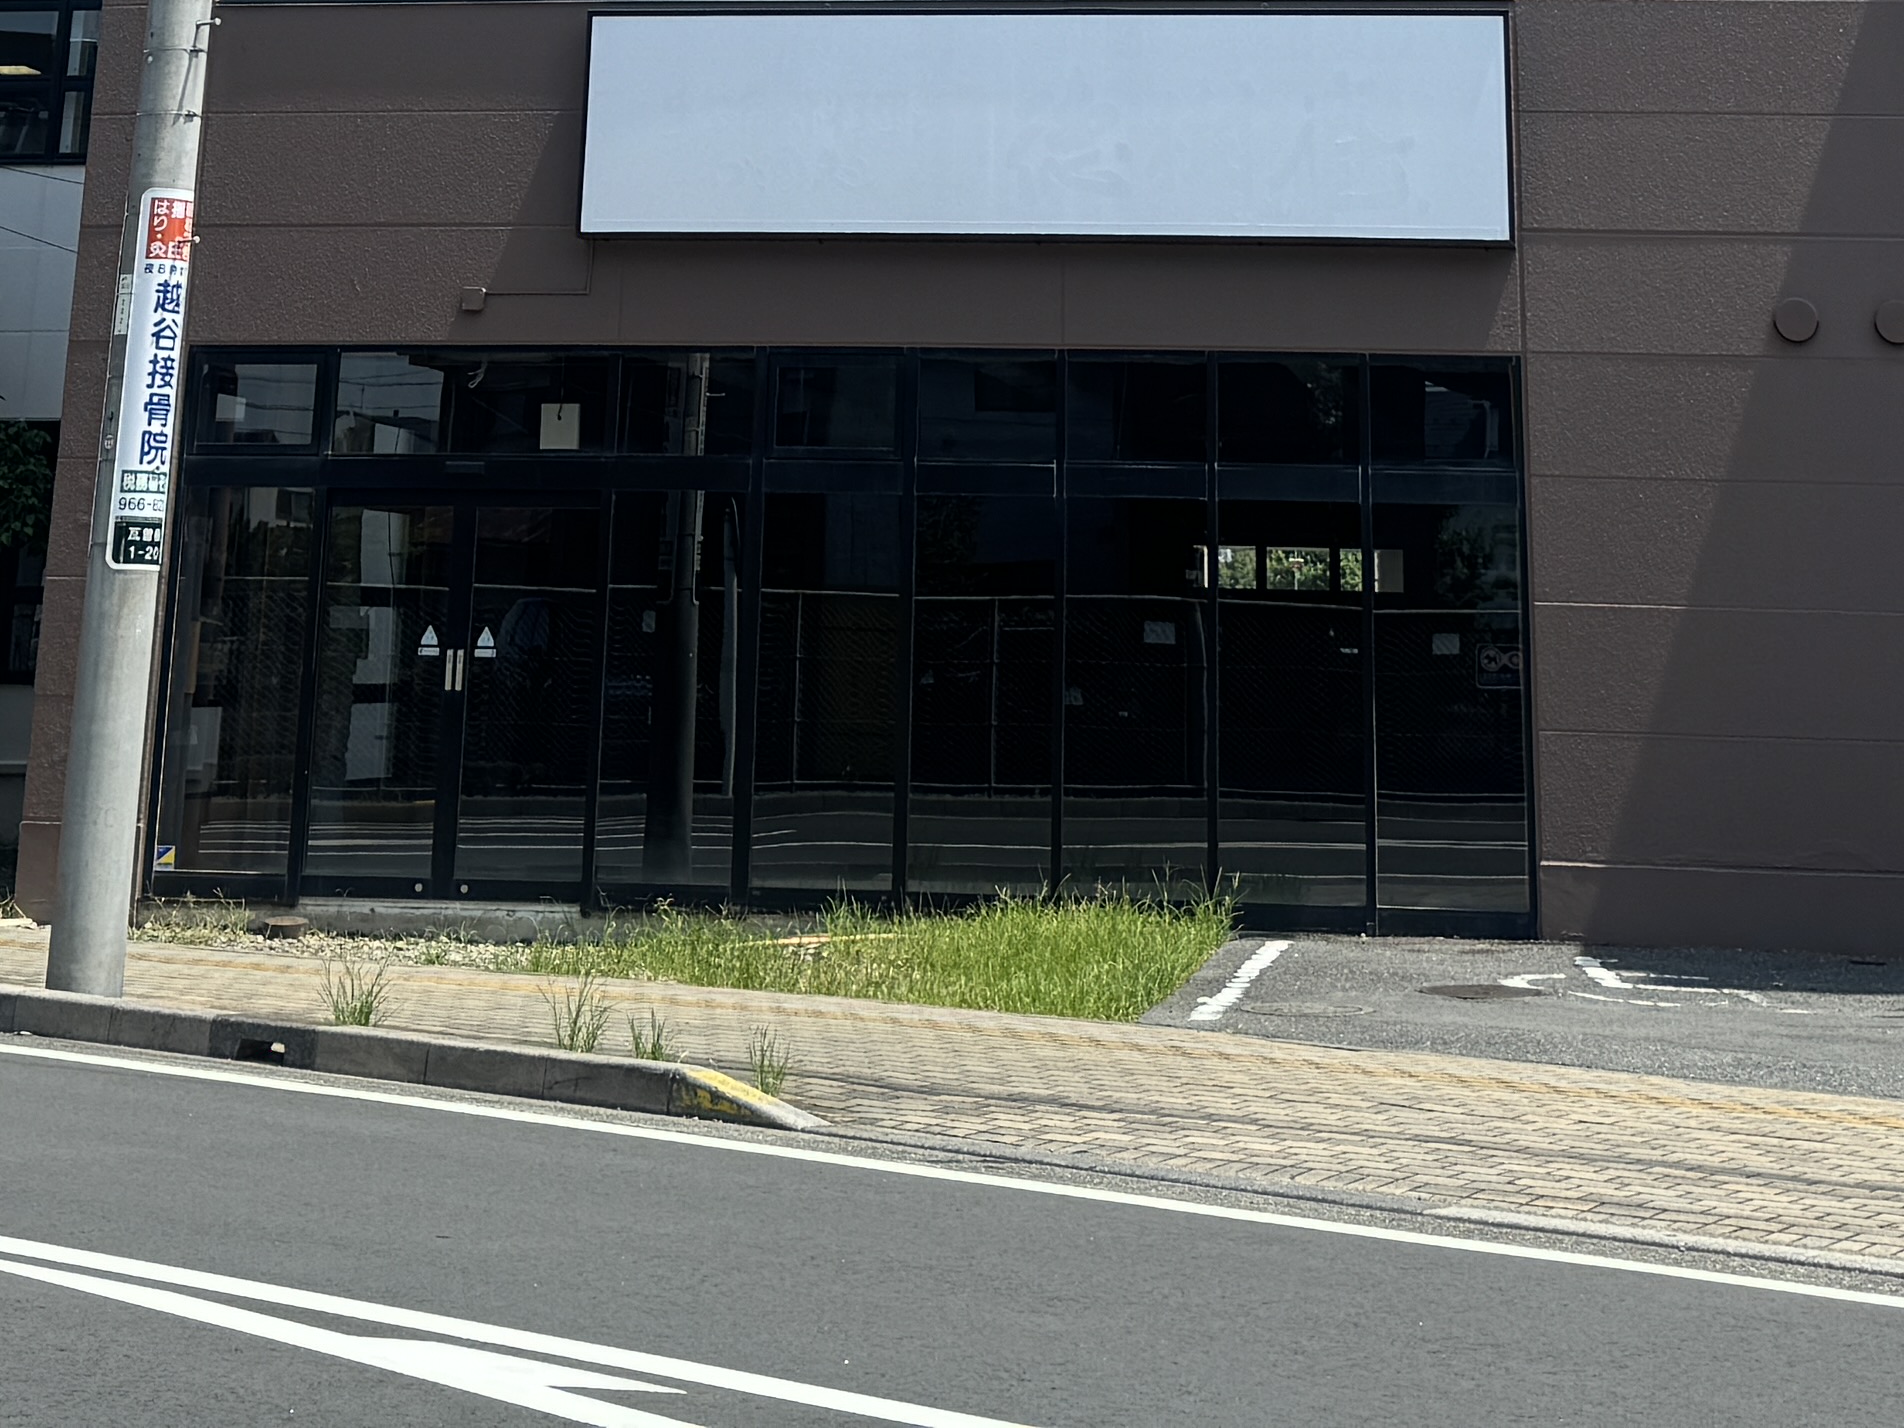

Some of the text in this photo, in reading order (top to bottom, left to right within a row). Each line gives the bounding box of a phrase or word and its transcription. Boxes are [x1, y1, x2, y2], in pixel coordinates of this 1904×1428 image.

[138, 278, 185, 467] 越谷接骨院
